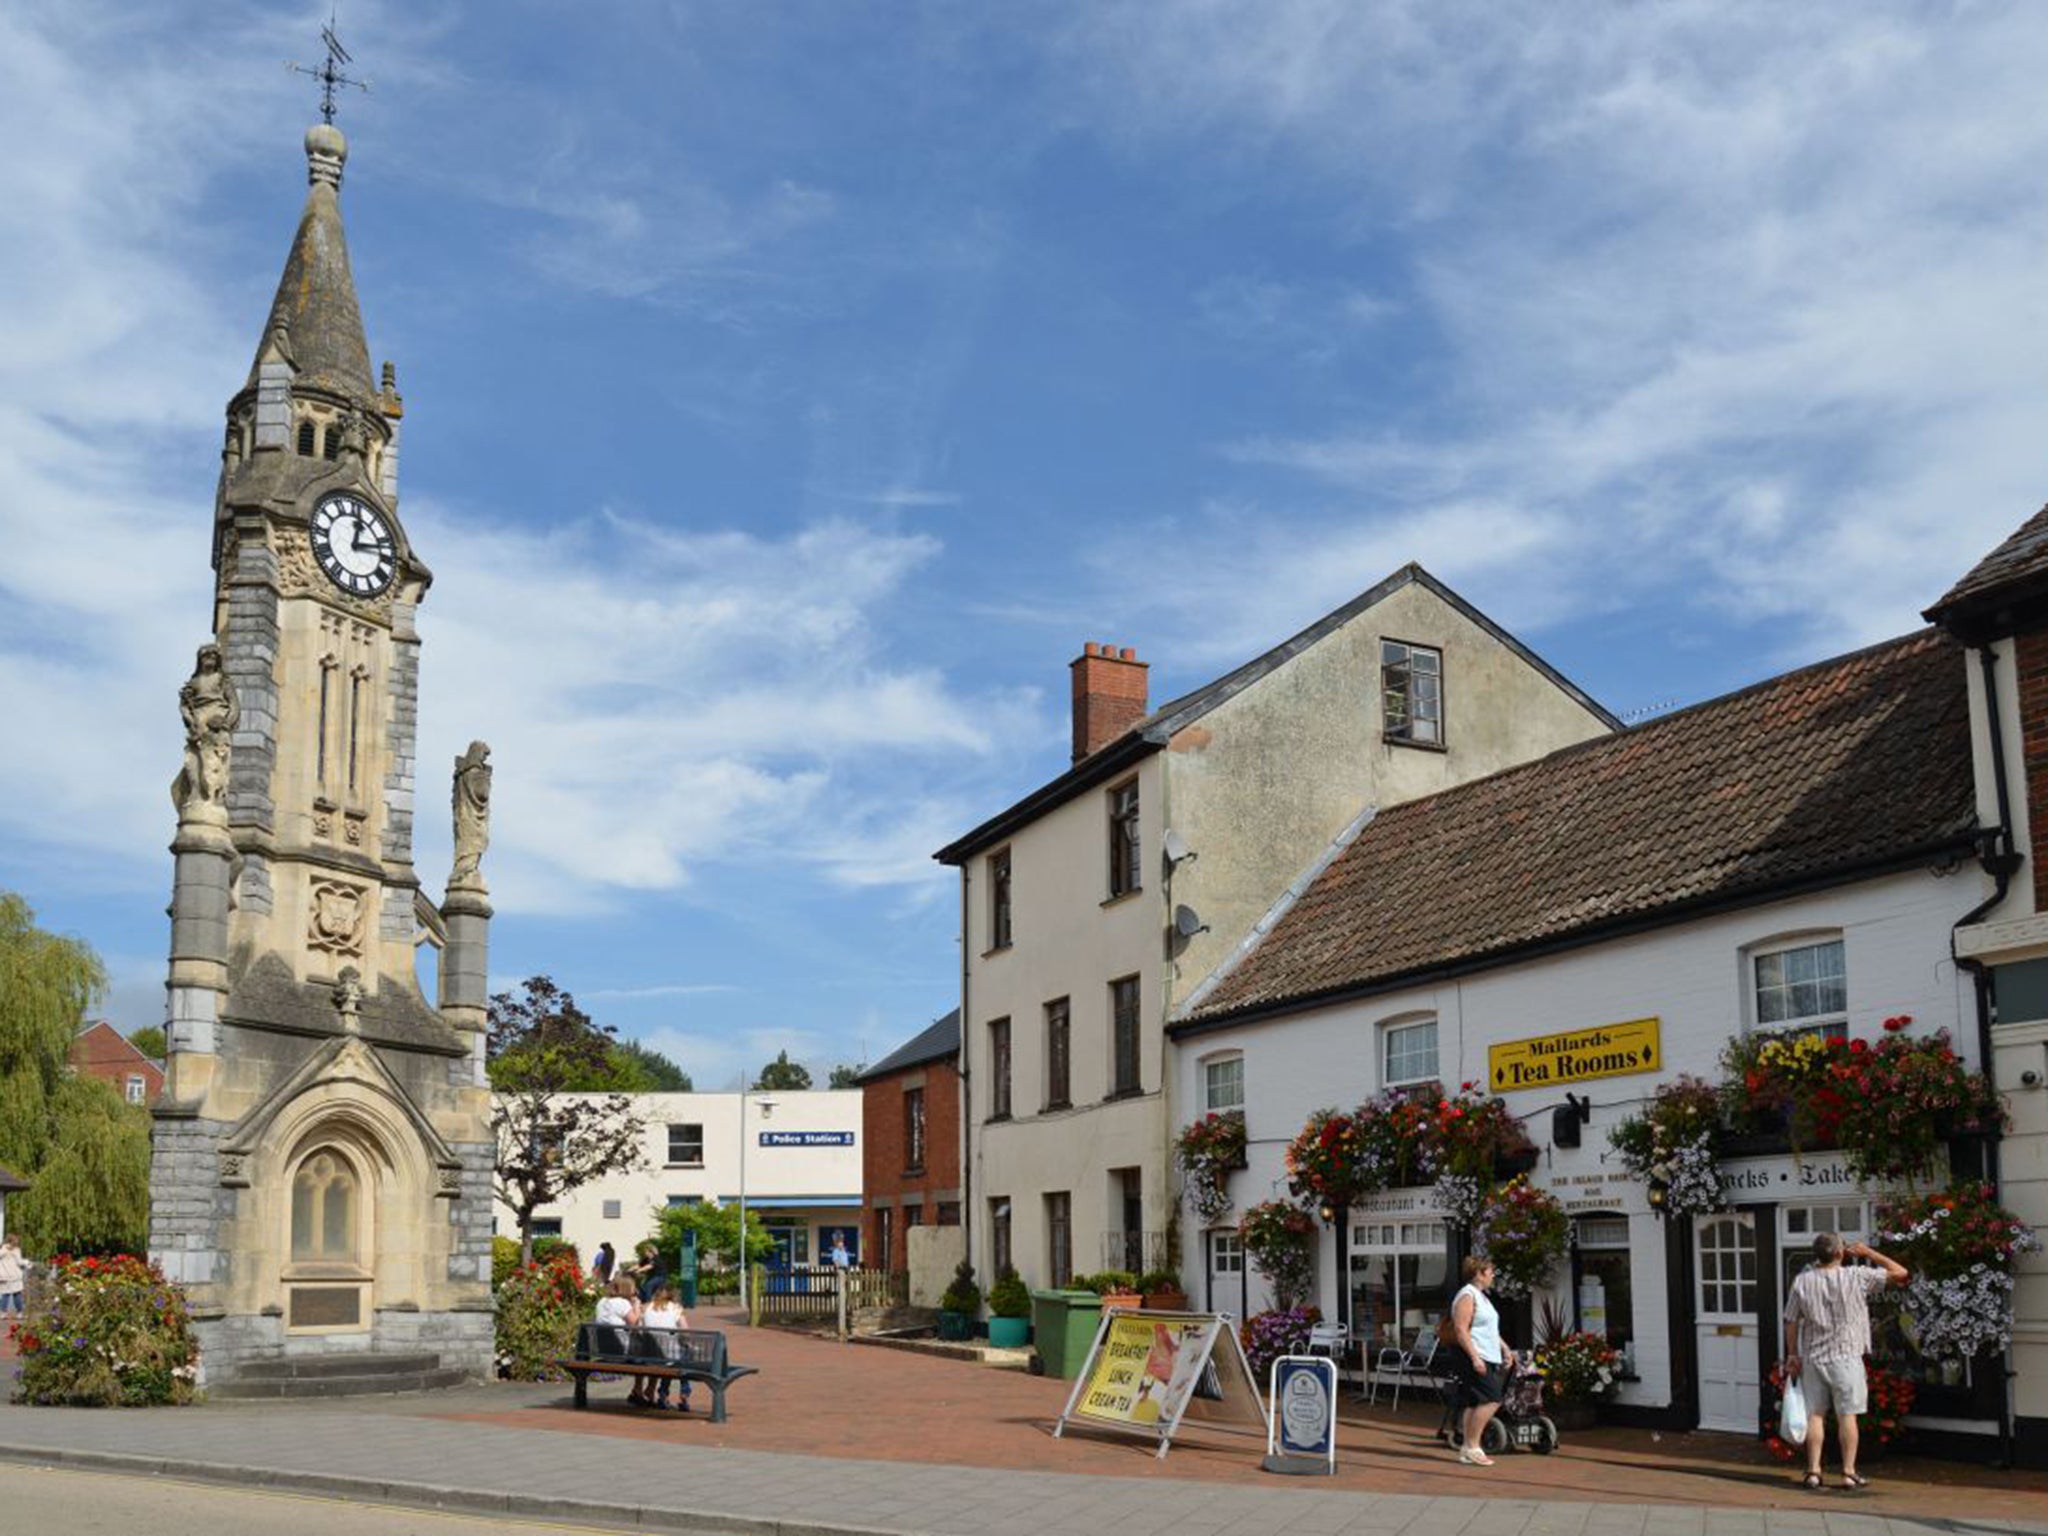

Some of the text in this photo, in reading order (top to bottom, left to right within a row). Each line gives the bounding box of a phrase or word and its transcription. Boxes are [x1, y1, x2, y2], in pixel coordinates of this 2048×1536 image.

[1529, 1032, 1612, 1057] Mallards
[1508, 1051, 1638, 1084] Tea Rooms
[772, 1134, 841, 1144] Police Station
